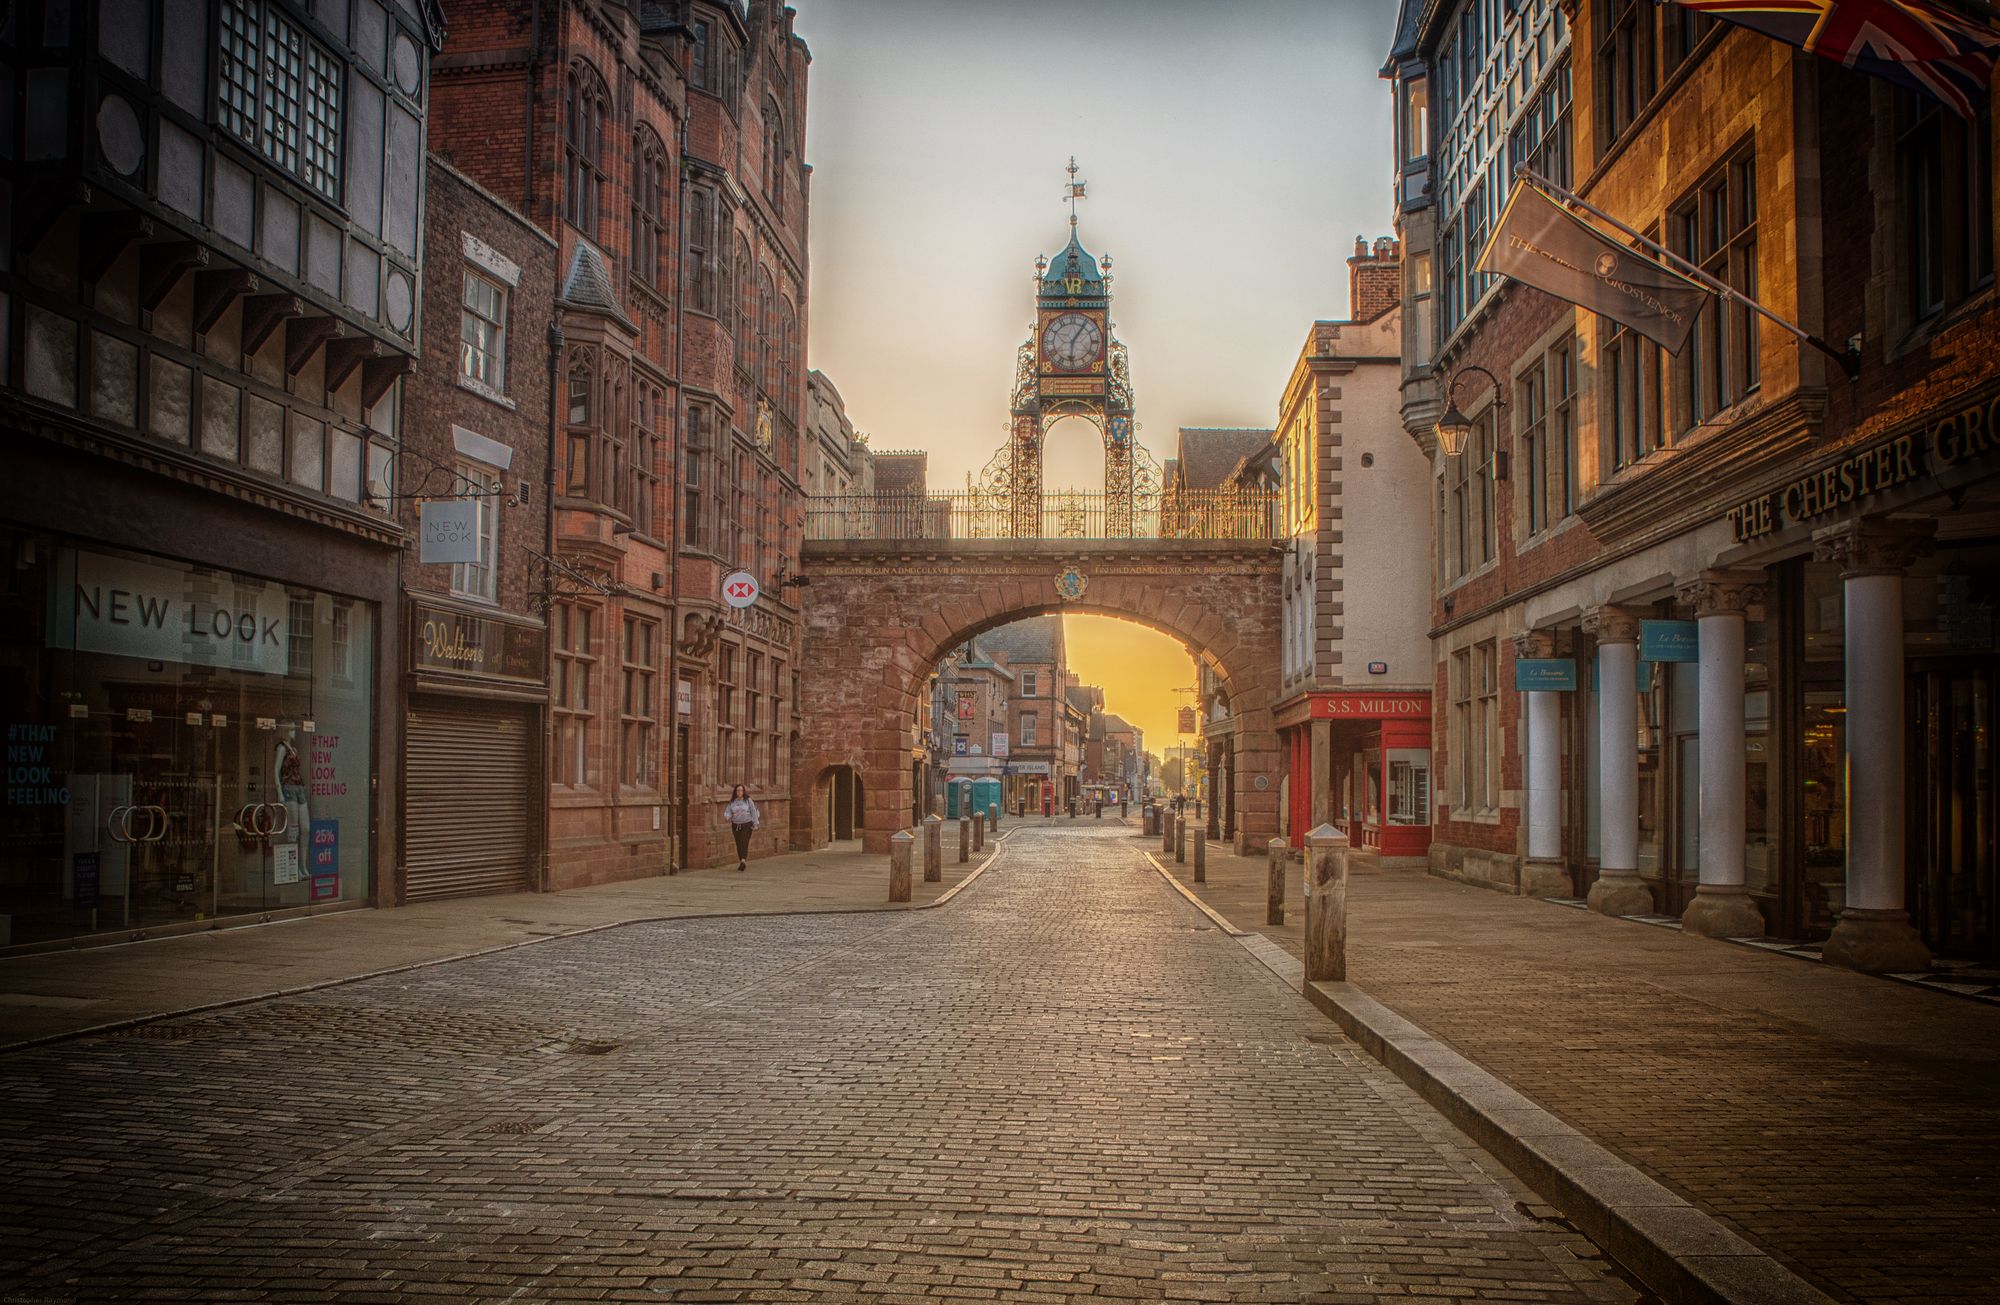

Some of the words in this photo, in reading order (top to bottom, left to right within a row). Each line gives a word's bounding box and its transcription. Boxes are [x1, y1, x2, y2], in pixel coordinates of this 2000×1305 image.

[1509, 233, 1537, 254] THE
[1604, 276, 1683, 328] GROSVENOR
[1042, 360, 1053, 373] 18
[1091, 360, 1104, 372] 97
[1726, 493, 1772, 544] THE
[1782, 434, 1918, 522] CHESTER
[429, 521, 467, 532] NEW
[426, 532, 471, 543] LOOK
[76, 583, 169, 629] NEW
[191, 604, 280, 647] LOOK
[423, 620, 484, 663] Waltons
[1327, 700, 1354, 713] S.S.
[1359, 700, 1422, 713] MILTON
[7, 722, 57, 742] #THAT
[311, 735, 340, 749] #THAT
[7, 744, 44, 763] NEW
[311, 751, 332, 764] NEW
[7, 766, 51, 785] LOOK
[311, 767, 336, 780] LOOK
[7, 786, 72, 806] FEELING
[311, 783, 347, 796] FEELING
[315, 829, 335, 843] 25%
[318, 847, 332, 862] off
